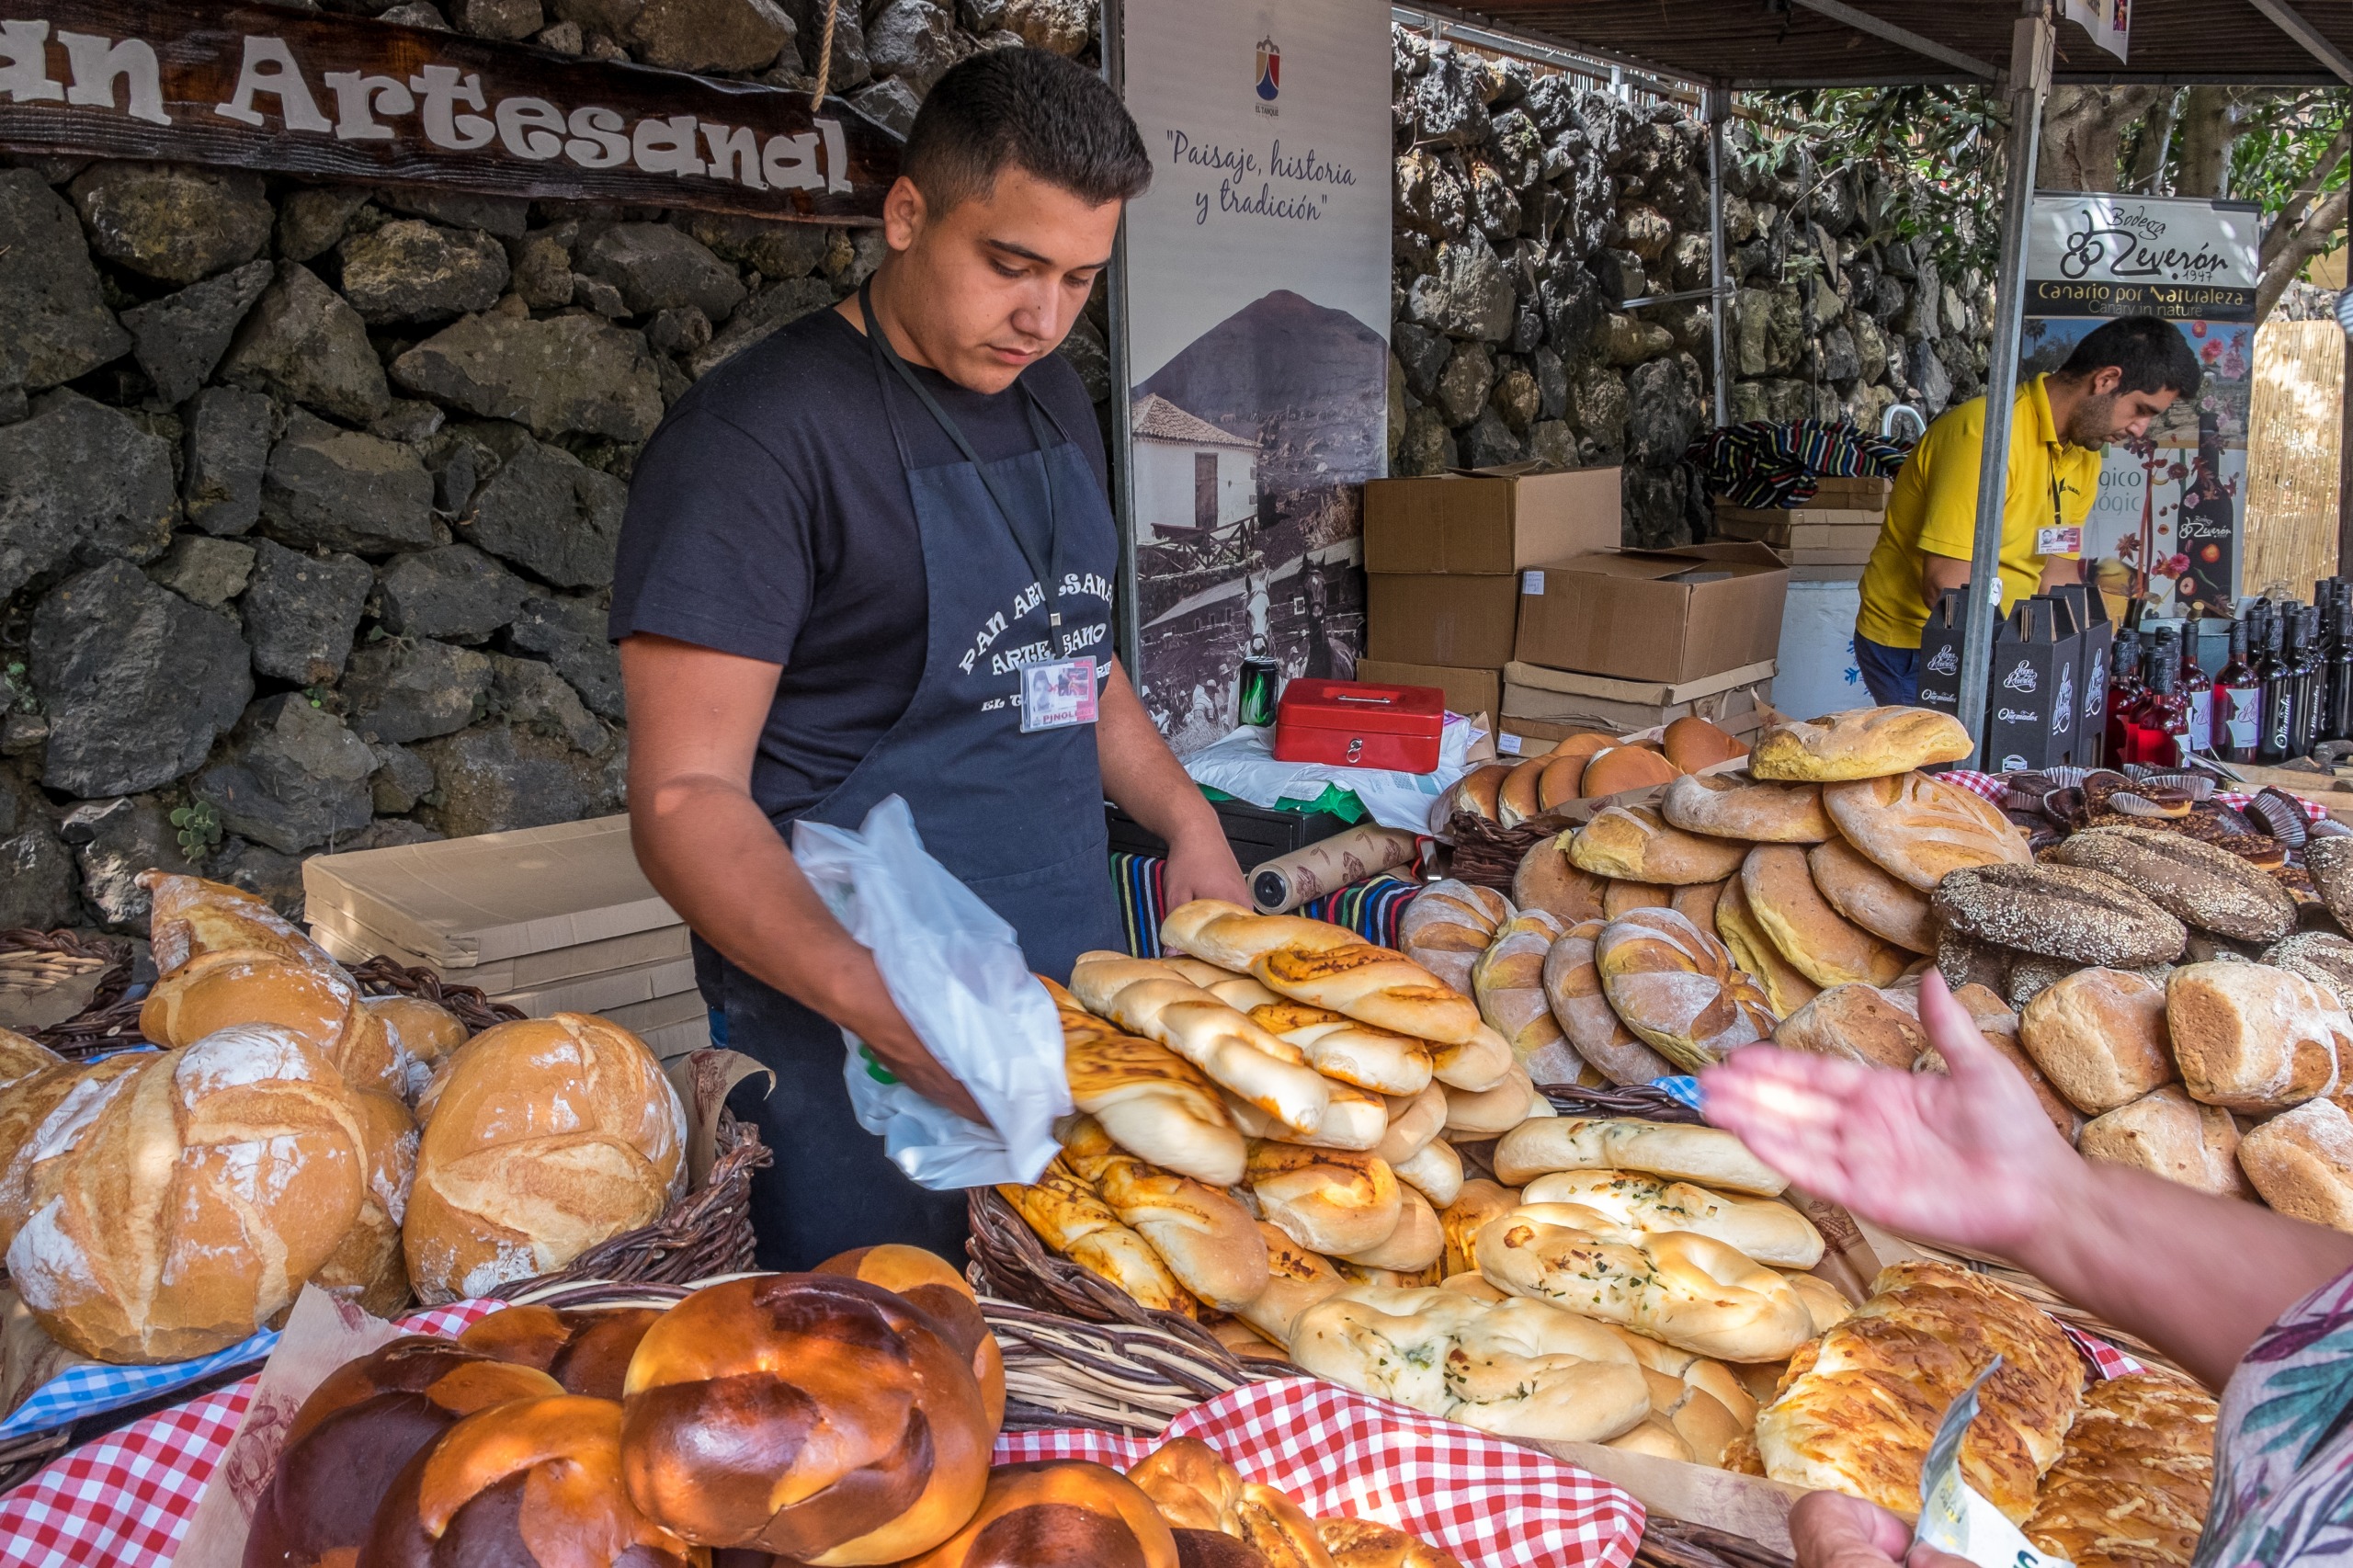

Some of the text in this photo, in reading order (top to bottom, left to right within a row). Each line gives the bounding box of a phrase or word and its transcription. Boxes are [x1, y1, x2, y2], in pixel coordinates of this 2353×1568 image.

[214, 36, 854, 195] Artesanal
[1166, 130, 1357, 186] "Paisaje, historia
[1196, 178, 1328, 225] y tradición"
[2107, 206, 2166, 240] Bodega
[2038, 281, 2245, 305] Canario por Naturaleza
[2182, 270, 2213, 282] 1947
[2087, 299, 2203, 317] Canary in nature
[959, 611, 1009, 676] PAN
[981, 699, 1006, 712] EL
